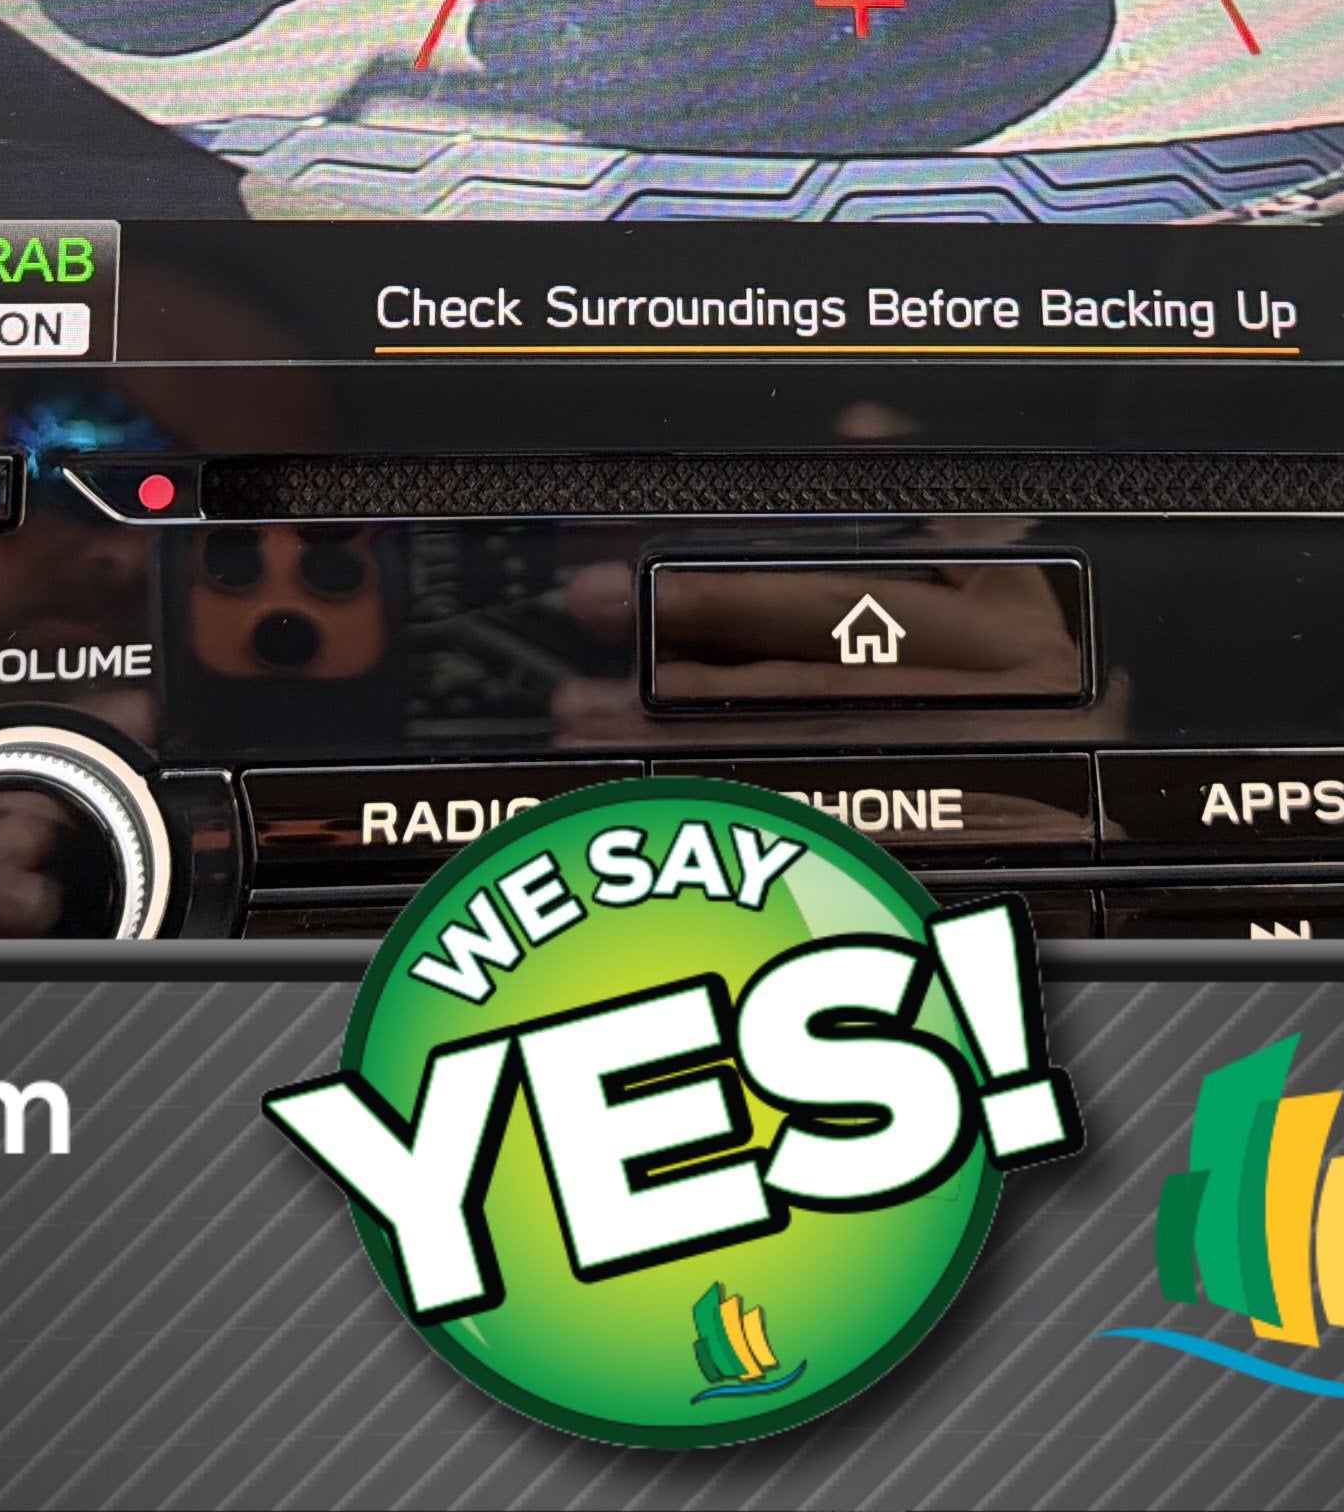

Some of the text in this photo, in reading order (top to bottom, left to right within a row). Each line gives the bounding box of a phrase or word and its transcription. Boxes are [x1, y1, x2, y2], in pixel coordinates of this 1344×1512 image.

[376, 285, 1298, 339] Check Surroundings Before Backing Up
